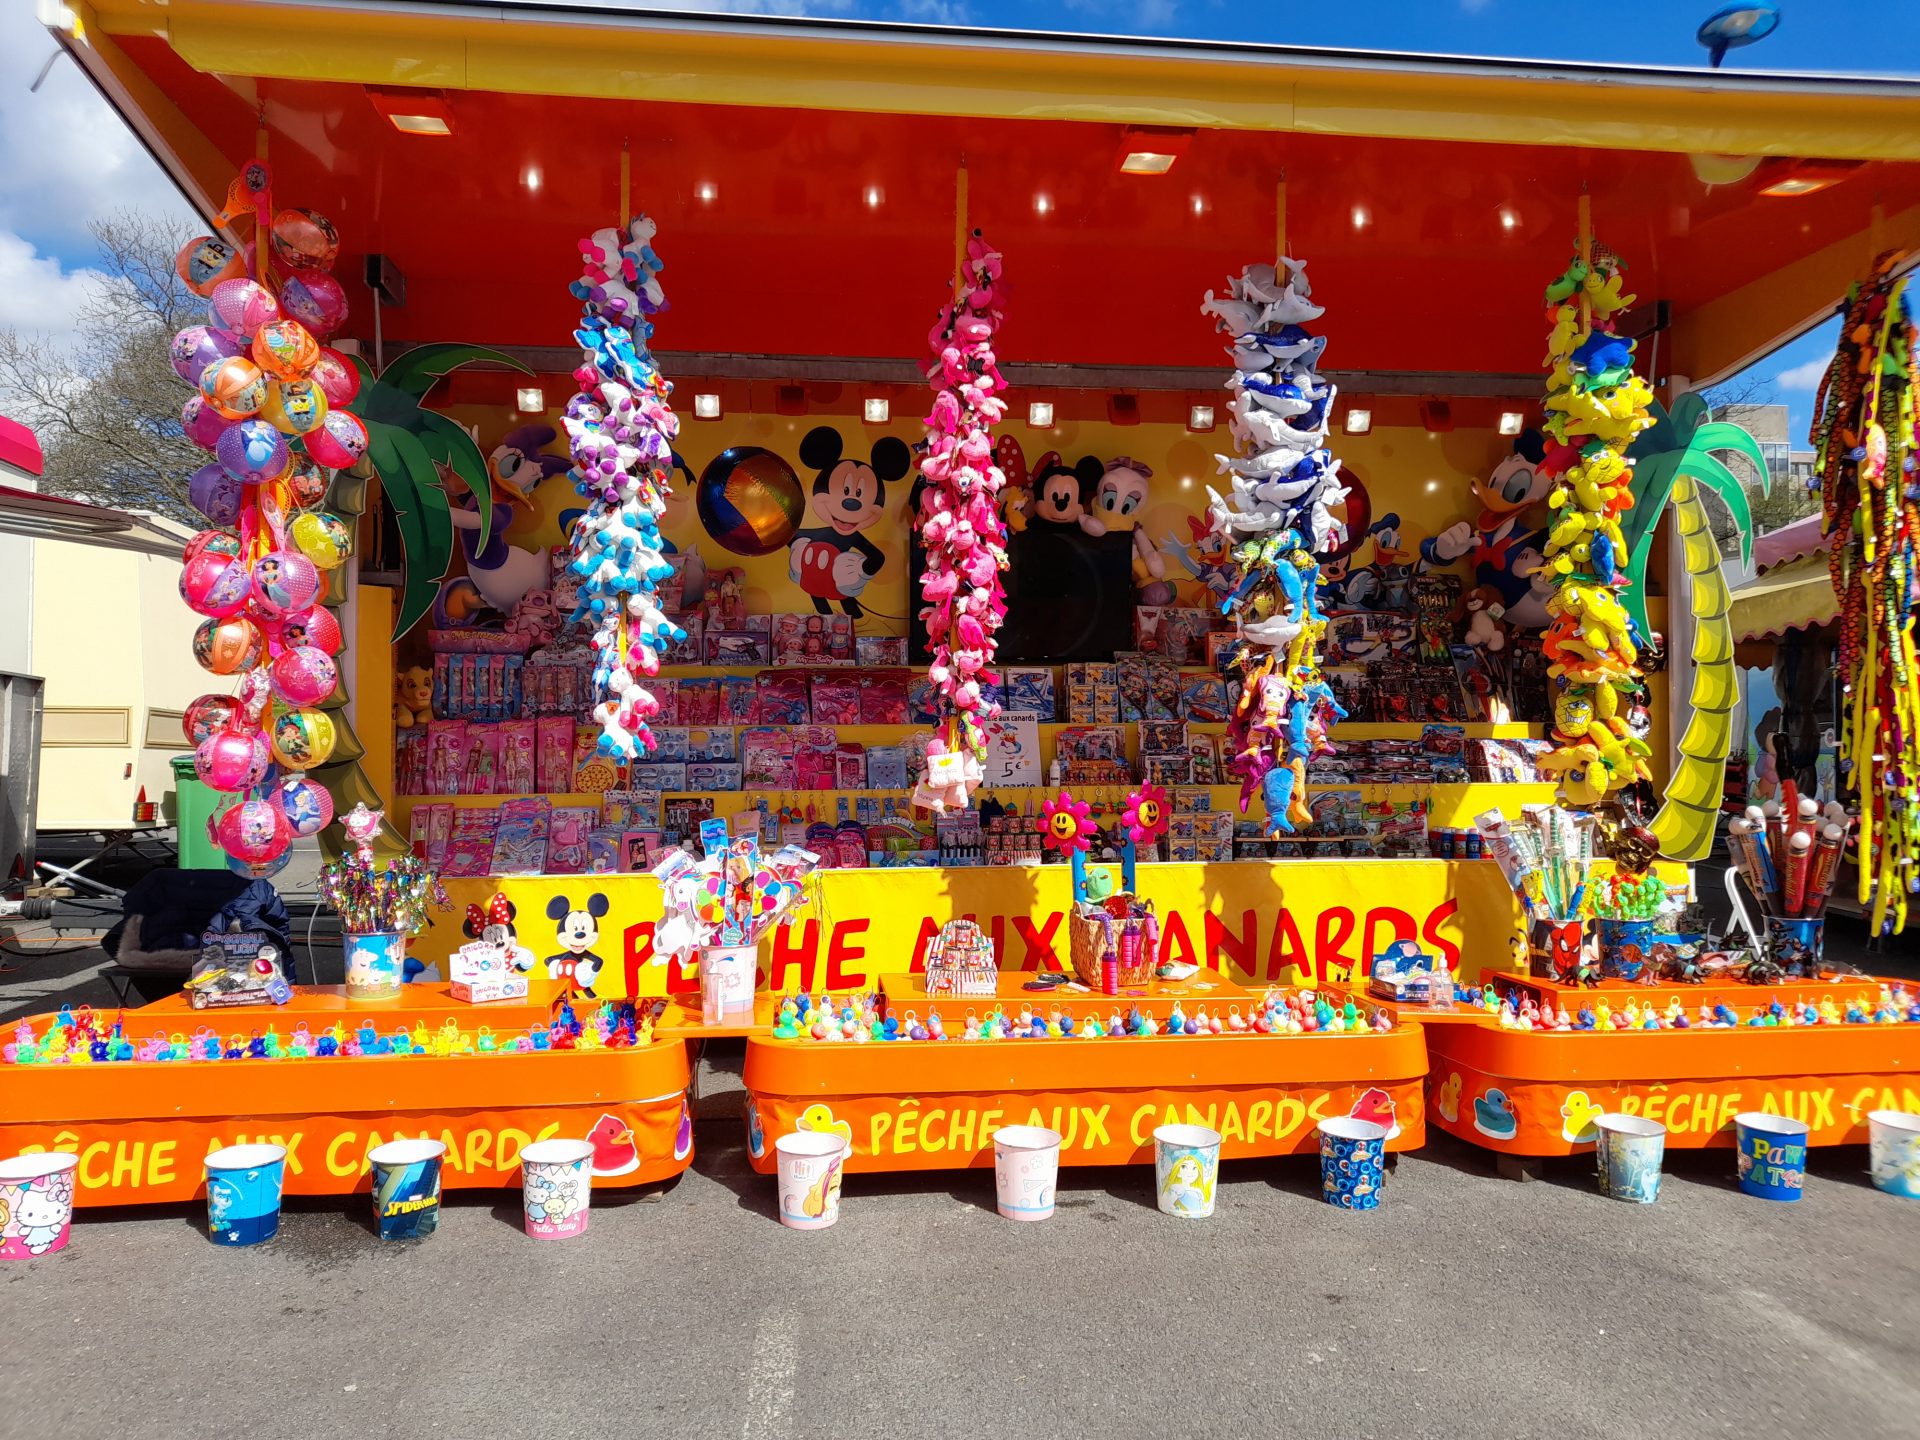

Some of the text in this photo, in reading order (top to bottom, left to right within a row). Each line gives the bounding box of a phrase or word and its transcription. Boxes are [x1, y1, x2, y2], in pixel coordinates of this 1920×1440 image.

[623, 918, 870, 998] PHE
[1157, 897, 1460, 982] ANARDS
[18, 1130, 177, 1189] CHE
[326, 1122, 559, 1176] CAARD
[871, 1097, 1003, 1156] PÊCHE
[532, 1223, 576, 1233] Hello Kitty
